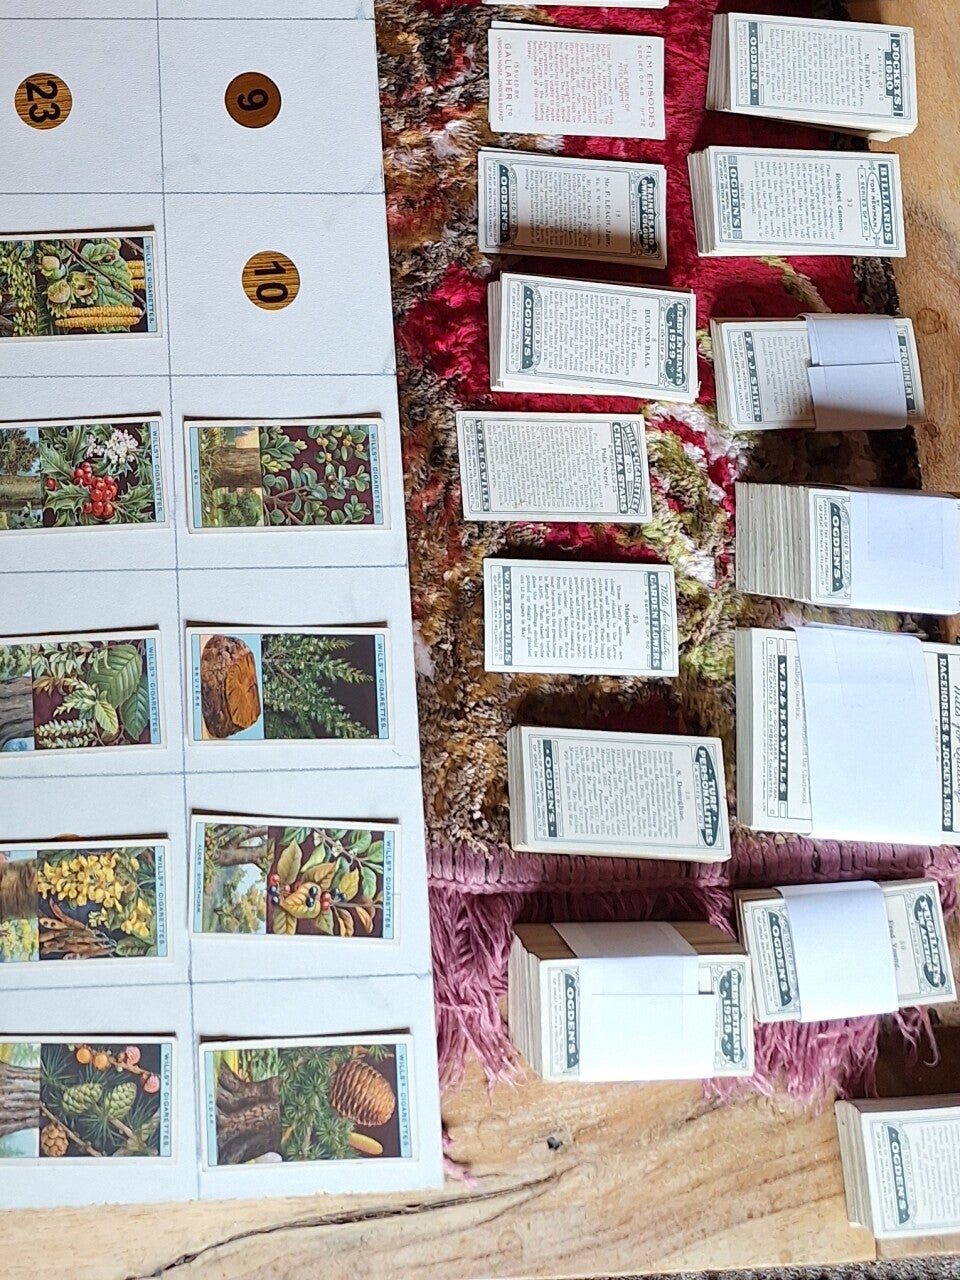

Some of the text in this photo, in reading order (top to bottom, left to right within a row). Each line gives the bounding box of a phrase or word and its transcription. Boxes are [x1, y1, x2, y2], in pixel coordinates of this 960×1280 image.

[750, 36, 758, 91] OGDEN'S
[892, 42, 901, 108] JOCKEYS,
[26, 81, 60, 123] 23
[237, 89, 268, 112] 9
[647, 73, 655, 128] EPISODES
[730, 168, 740, 226] OGDEN'S
[835, 173, 843, 202] Ricochet
[881, 167, 892, 241] BILLIARDS
[253, 260, 288, 303] 10
[524, 298, 532, 356] OGDEN'S
[746, 336, 753, 347] F.
[676, 336, 684, 385] ENTRANTS
[748, 360, 755, 369] J.
[900, 346, 913, 400] PROMINENT
[749, 371, 760, 415] SMITH
[613, 424, 626, 511] CINEMA STARS
[630, 456, 641, 509] CIGARETTES
[832, 516, 840, 579] OGDEN'S
[650, 575, 659, 667] GARDEN FLOWERS
[660, 585, 668, 607] Wills
[661, 610, 670, 621] for
[939, 658, 949, 731] RACEHORSES
[942, 734, 948, 742] &
[544, 757, 554, 823] OGDEN'S
[699, 750, 713, 844] PERSONALITIES
[708, 779, 717, 812] TURF
[773, 926, 788, 991] OGDEN'S
[918, 912, 932, 972] IN ACTION
[920, 902, 940, 984] PUGILISTS
[567, 987, 576, 1054] OGDEN'S
[724, 1000, 732, 1034] 1928
[731, 971, 741, 1062] DERBY ENTRANTS
[892, 1142, 906, 1209] OGDEN'S
